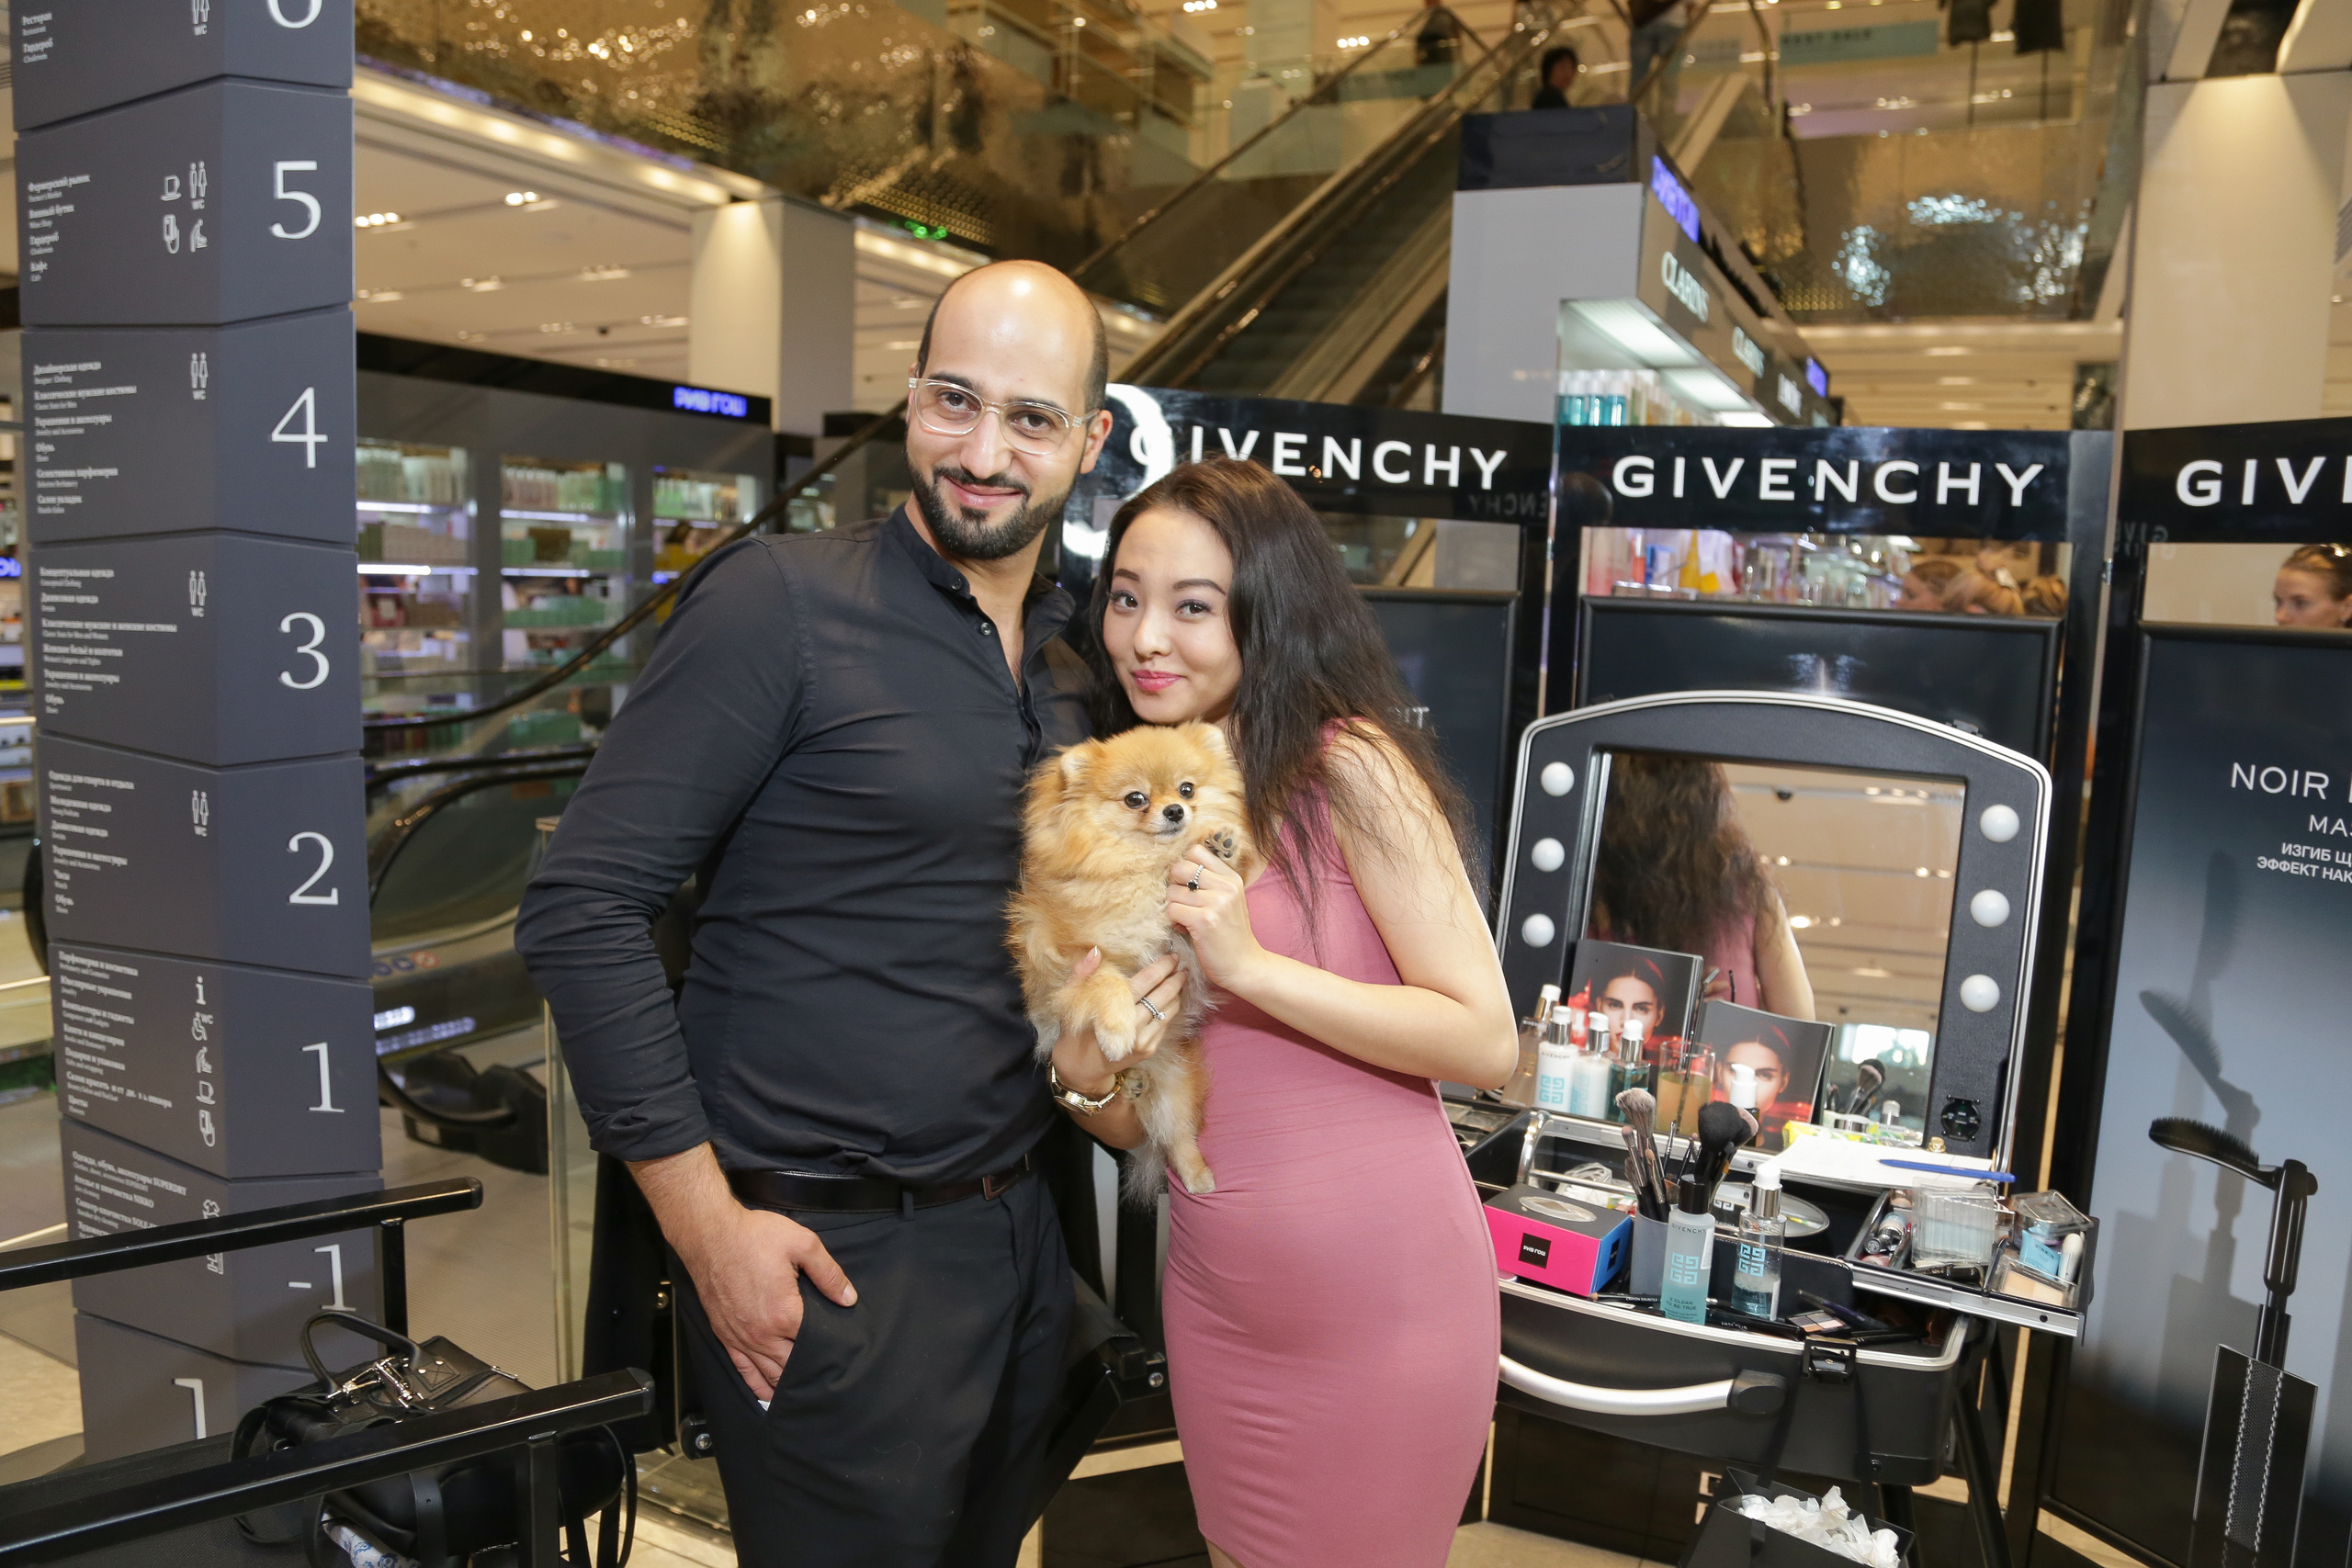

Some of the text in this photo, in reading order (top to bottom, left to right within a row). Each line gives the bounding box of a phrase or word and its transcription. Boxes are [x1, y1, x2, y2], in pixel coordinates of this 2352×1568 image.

[269, 161, 322, 239] 5
[270, 386, 328, 468] 4
[1613, 456, 2042, 506] GIVENCHY
[278, 612, 330, 689] 3
[2231, 761, 2329, 800] NOIR
[2280, 842, 2331, 862] ИЗГИБ
[2309, 814, 2352, 838] MA
[287, 831, 339, 905] 2
[2256, 856, 2319, 878] ЭФФЕКТ
[300, 1042, 345, 1113] 1
[1672, 1224, 1707, 1234] GIVENCHY
[288, 1244, 356, 1312] -1
